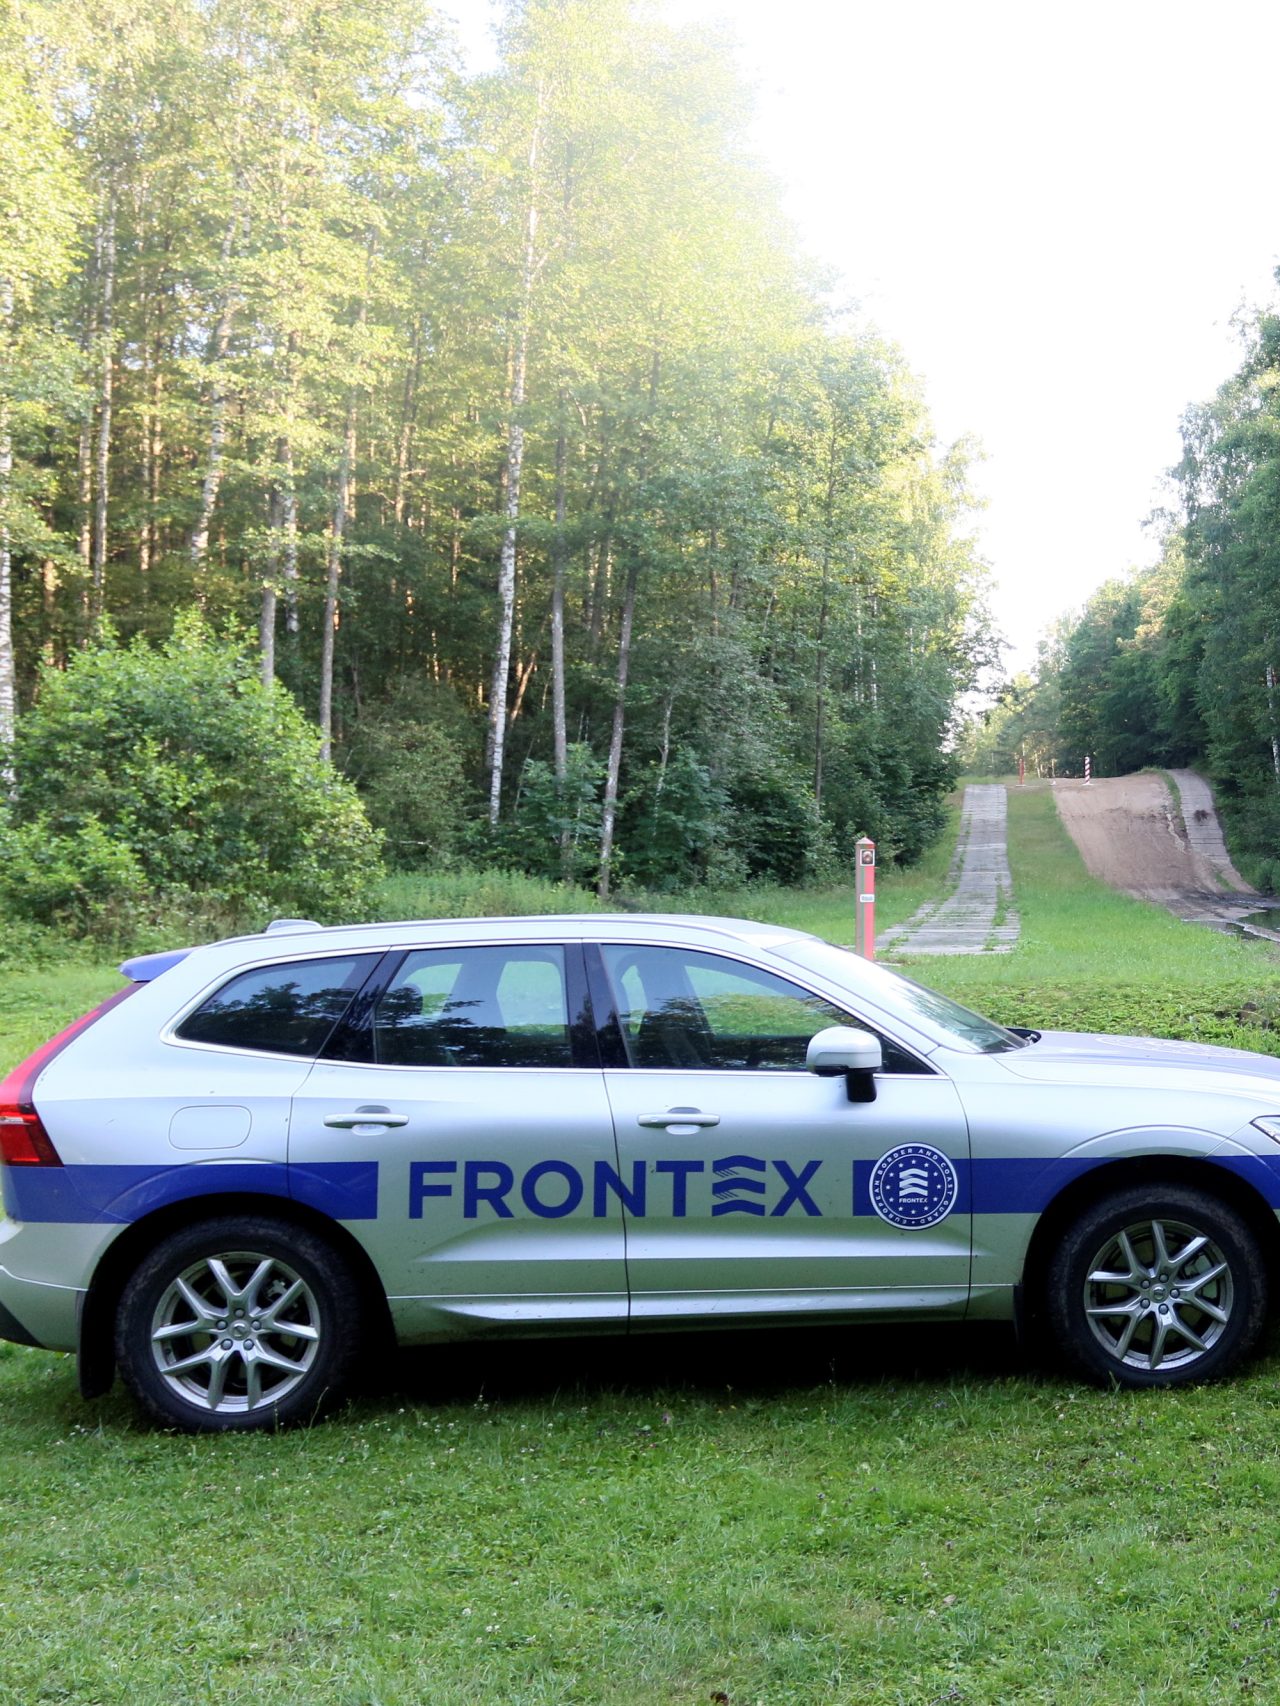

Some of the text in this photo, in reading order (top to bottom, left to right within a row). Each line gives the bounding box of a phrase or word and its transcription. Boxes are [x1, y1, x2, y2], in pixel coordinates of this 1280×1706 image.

[409, 1155, 823, 1218] FRONTEX
[874, 1148, 954, 1224] EUROPEAN BORDER AND COAST GUARD
